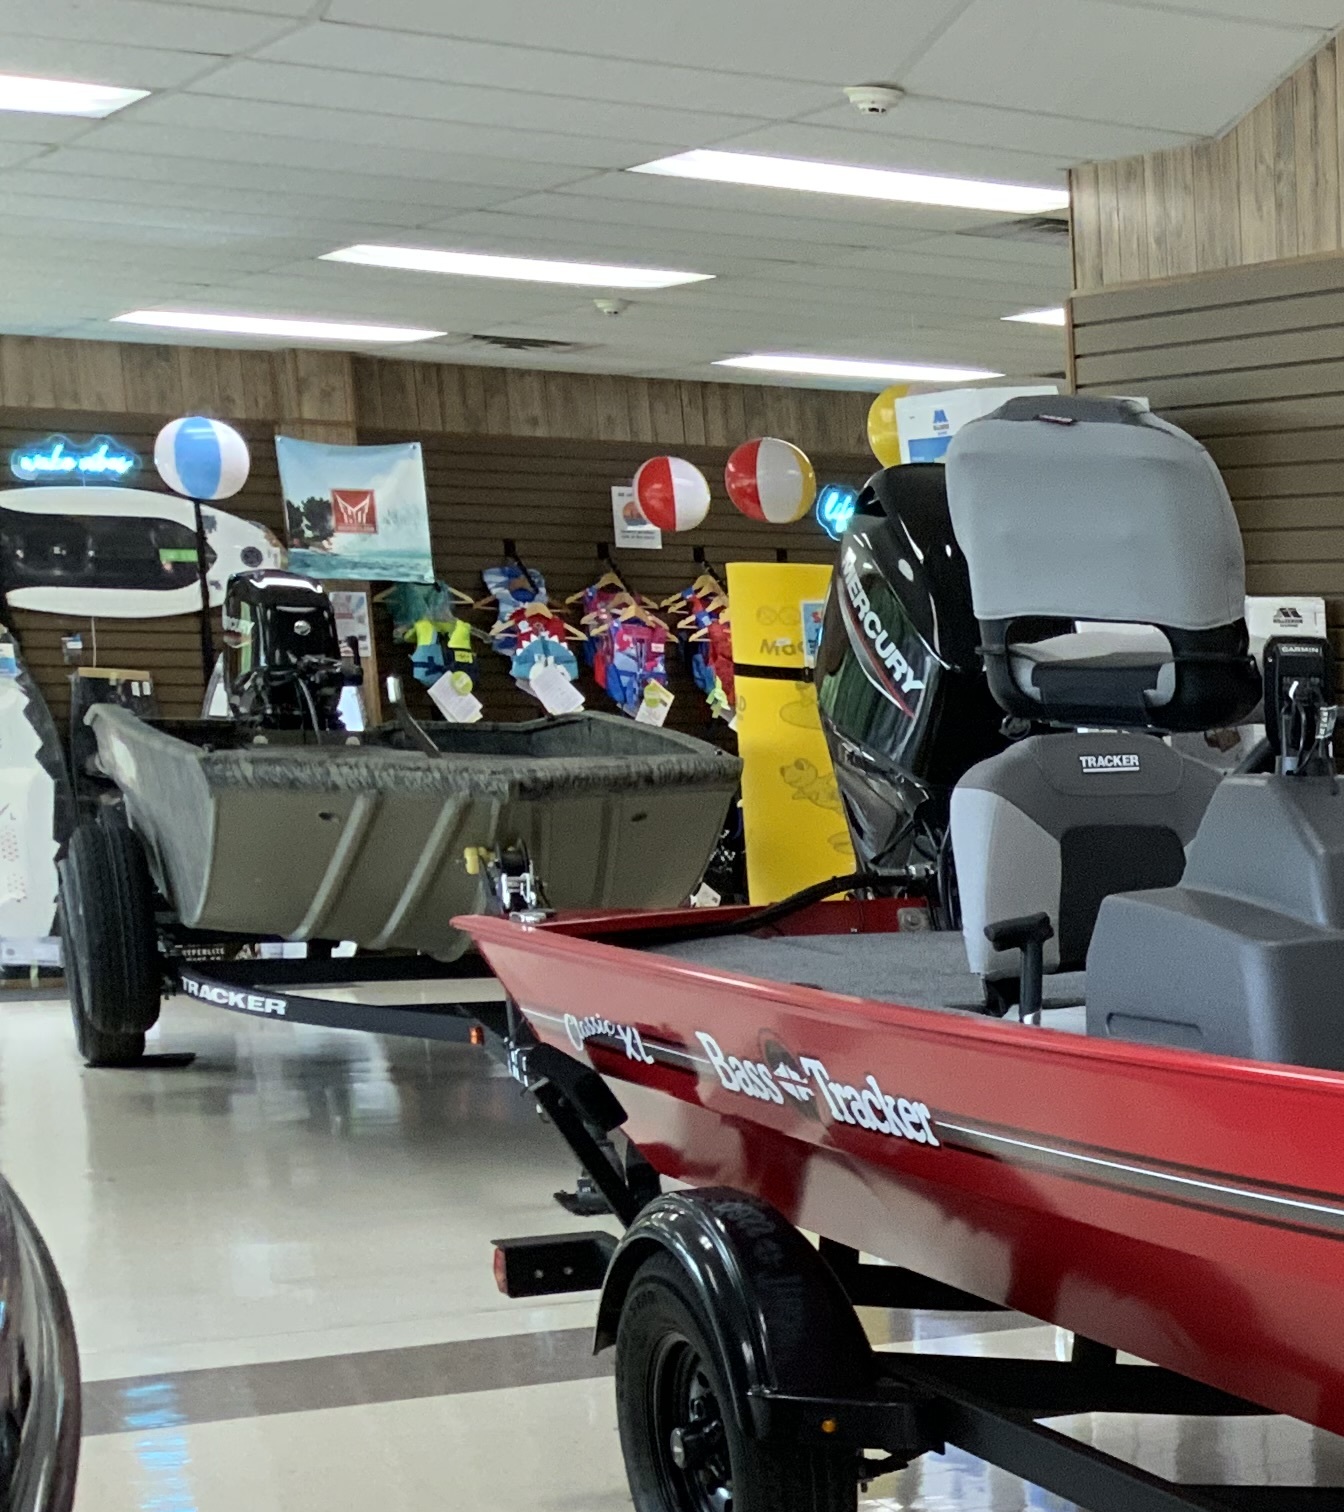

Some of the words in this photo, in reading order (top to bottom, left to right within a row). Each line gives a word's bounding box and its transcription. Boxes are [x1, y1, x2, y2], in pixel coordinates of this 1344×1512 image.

[842, 547, 926, 695] MERCURY
[1080, 755, 1139, 768] TRACKER
[180, 975, 286, 1015] TRACKER
[563, 1013, 615, 1051] Classic
[695, 1031, 785, 1105] Bass
[799, 1056, 941, 1147] Tracker
